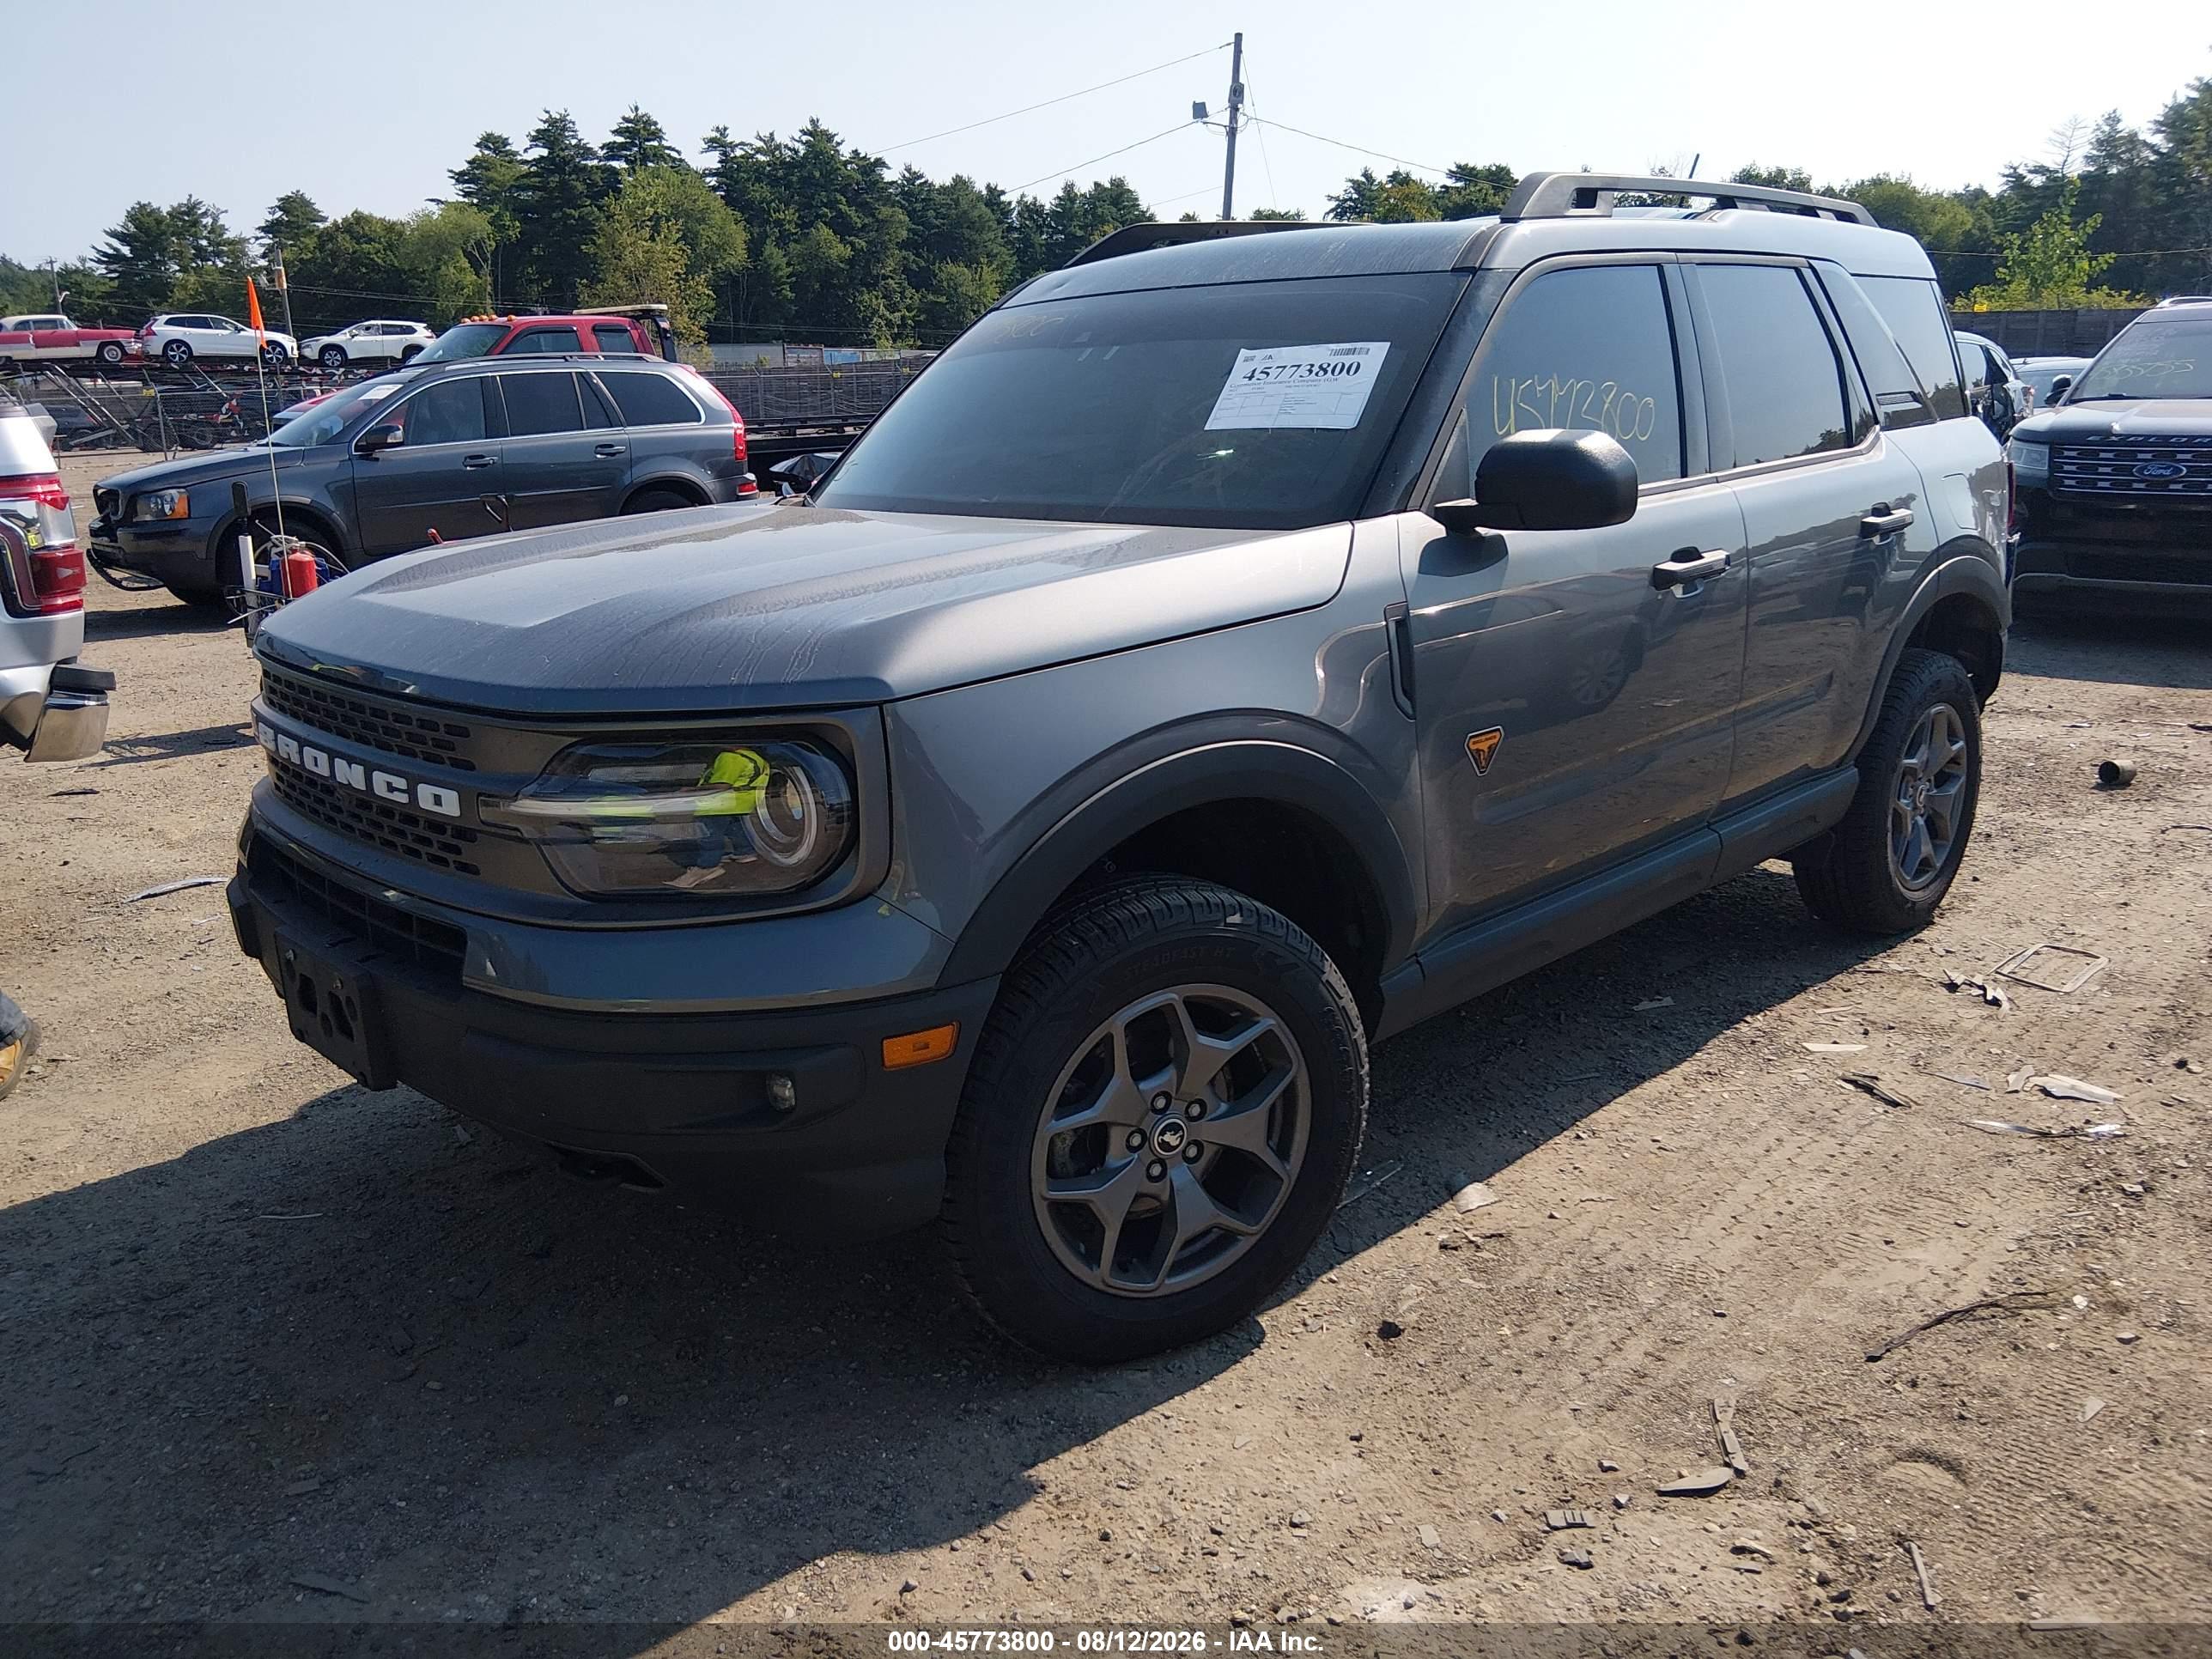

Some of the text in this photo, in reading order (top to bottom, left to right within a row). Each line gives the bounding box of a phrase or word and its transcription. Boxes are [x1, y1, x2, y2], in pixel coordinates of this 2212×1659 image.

[1243, 361, 1361, 381] 45773800
[2143, 464, 2173, 475] Ford
[258, 721, 461, 817] BRONCO
